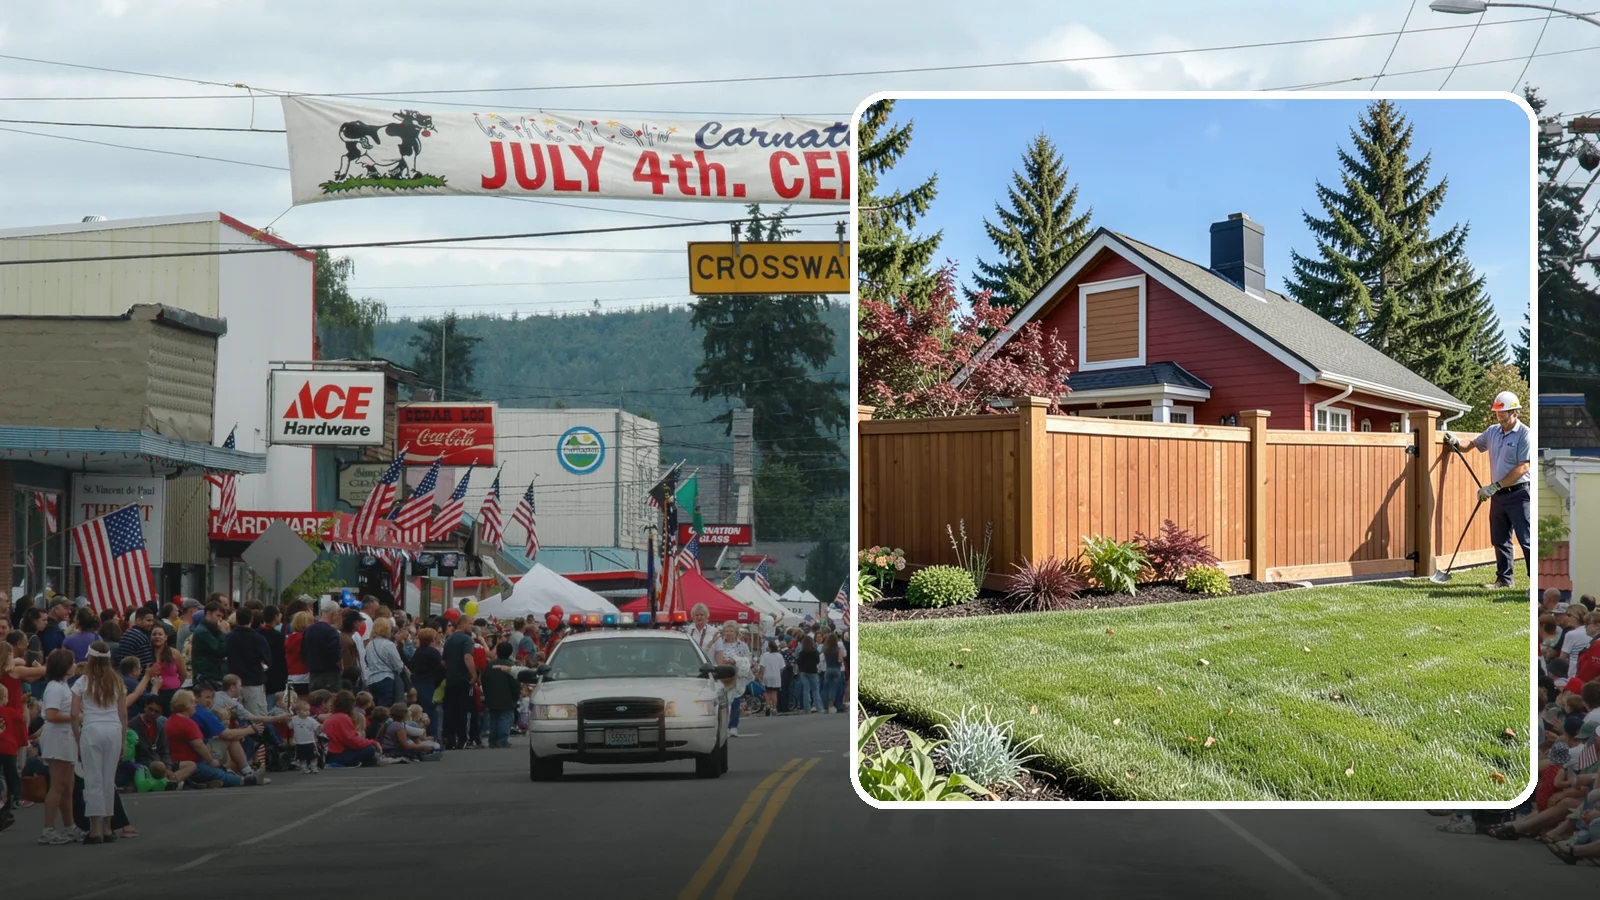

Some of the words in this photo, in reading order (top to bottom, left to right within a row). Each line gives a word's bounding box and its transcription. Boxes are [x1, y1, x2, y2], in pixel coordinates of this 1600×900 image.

[481, 141, 605, 192] JULY
[632, 150, 746, 198] 4th.
[697, 254, 850, 280] CROSSWA
[283, 380, 373, 420] ACE
[405, 409, 452, 422] CEDAR
[461, 409, 485, 422] LOG
[283, 421, 370, 436] Hardware
[416, 428, 476, 447] Coca-Cola
[83, 485, 94, 494] St.
[96, 485, 124, 495] Vincent
[126, 486, 136, 495] de
[137, 486, 155, 495] Paul
[688, 526, 741, 535] CRNATION
[699, 535, 730, 543] GLASS
